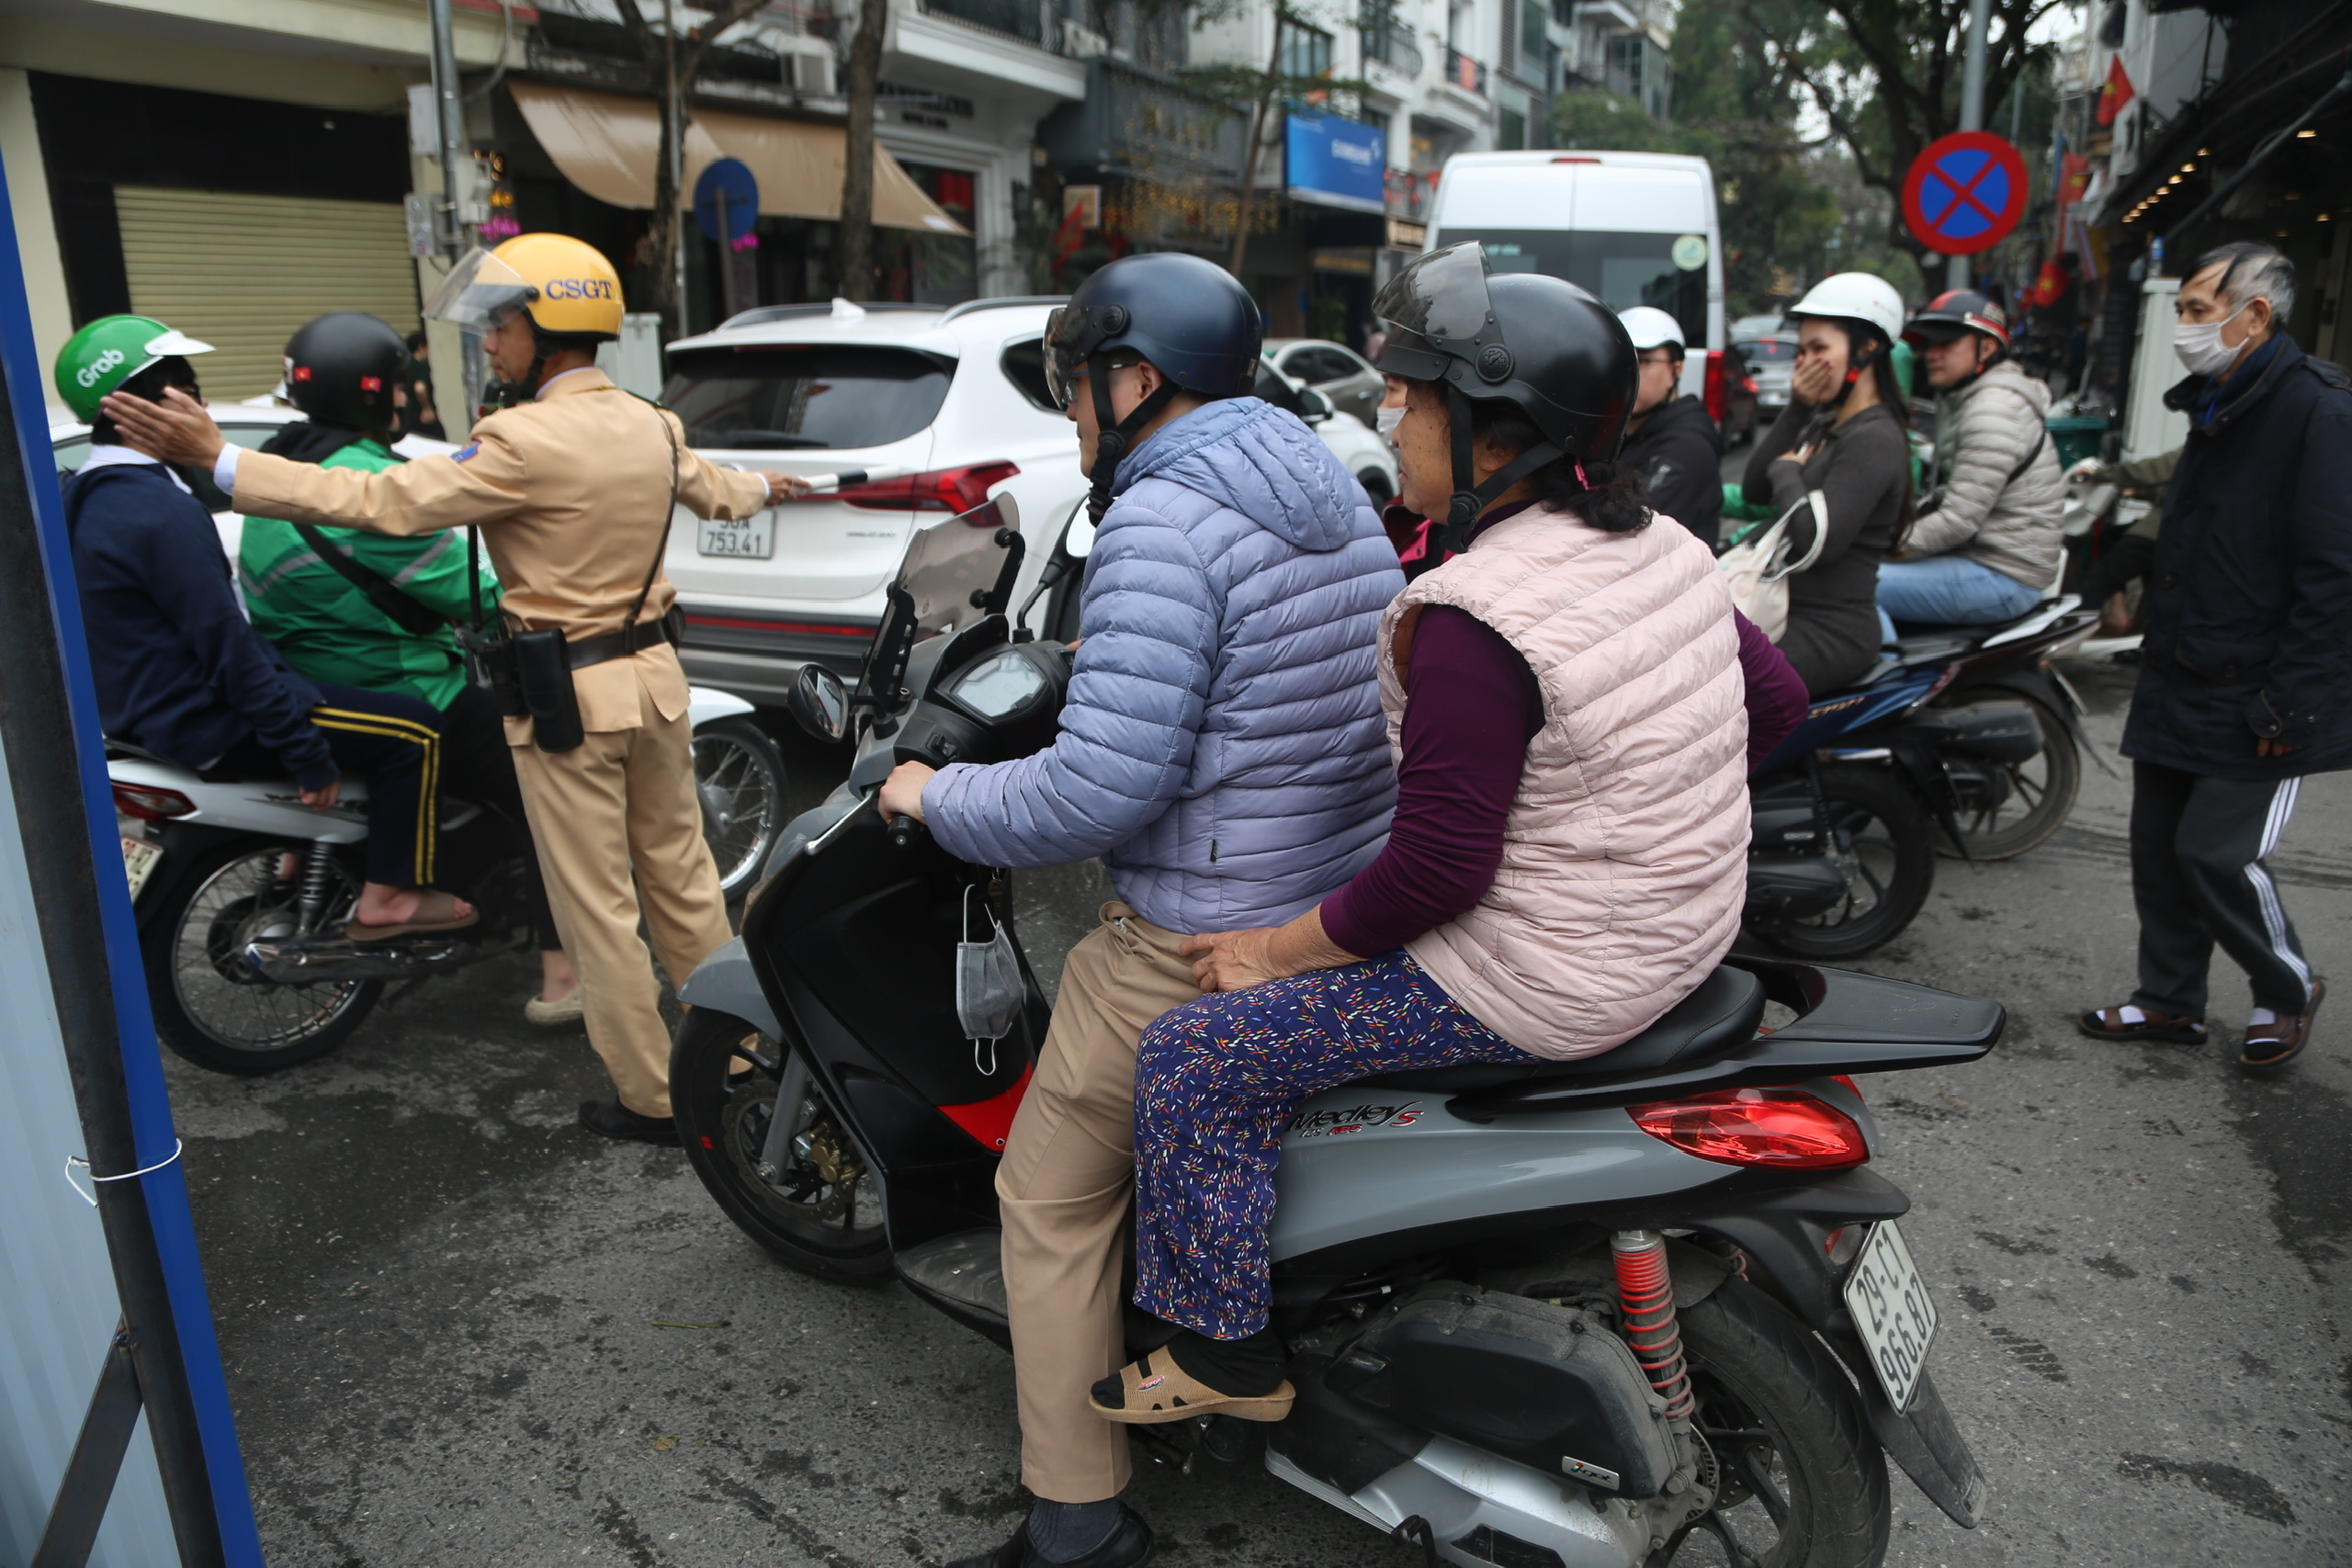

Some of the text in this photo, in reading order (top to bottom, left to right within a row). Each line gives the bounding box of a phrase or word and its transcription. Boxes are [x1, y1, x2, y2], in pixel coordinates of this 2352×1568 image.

[545, 278, 612, 300] CSGT
[76, 349, 125, 388] Grab
[706, 531, 761, 555] 753.41
[1285, 1100, 1423, 1133] Medley
[1856, 1225, 1905, 1336] 29-C1
[1880, 1271, 1932, 1400] 966.87
